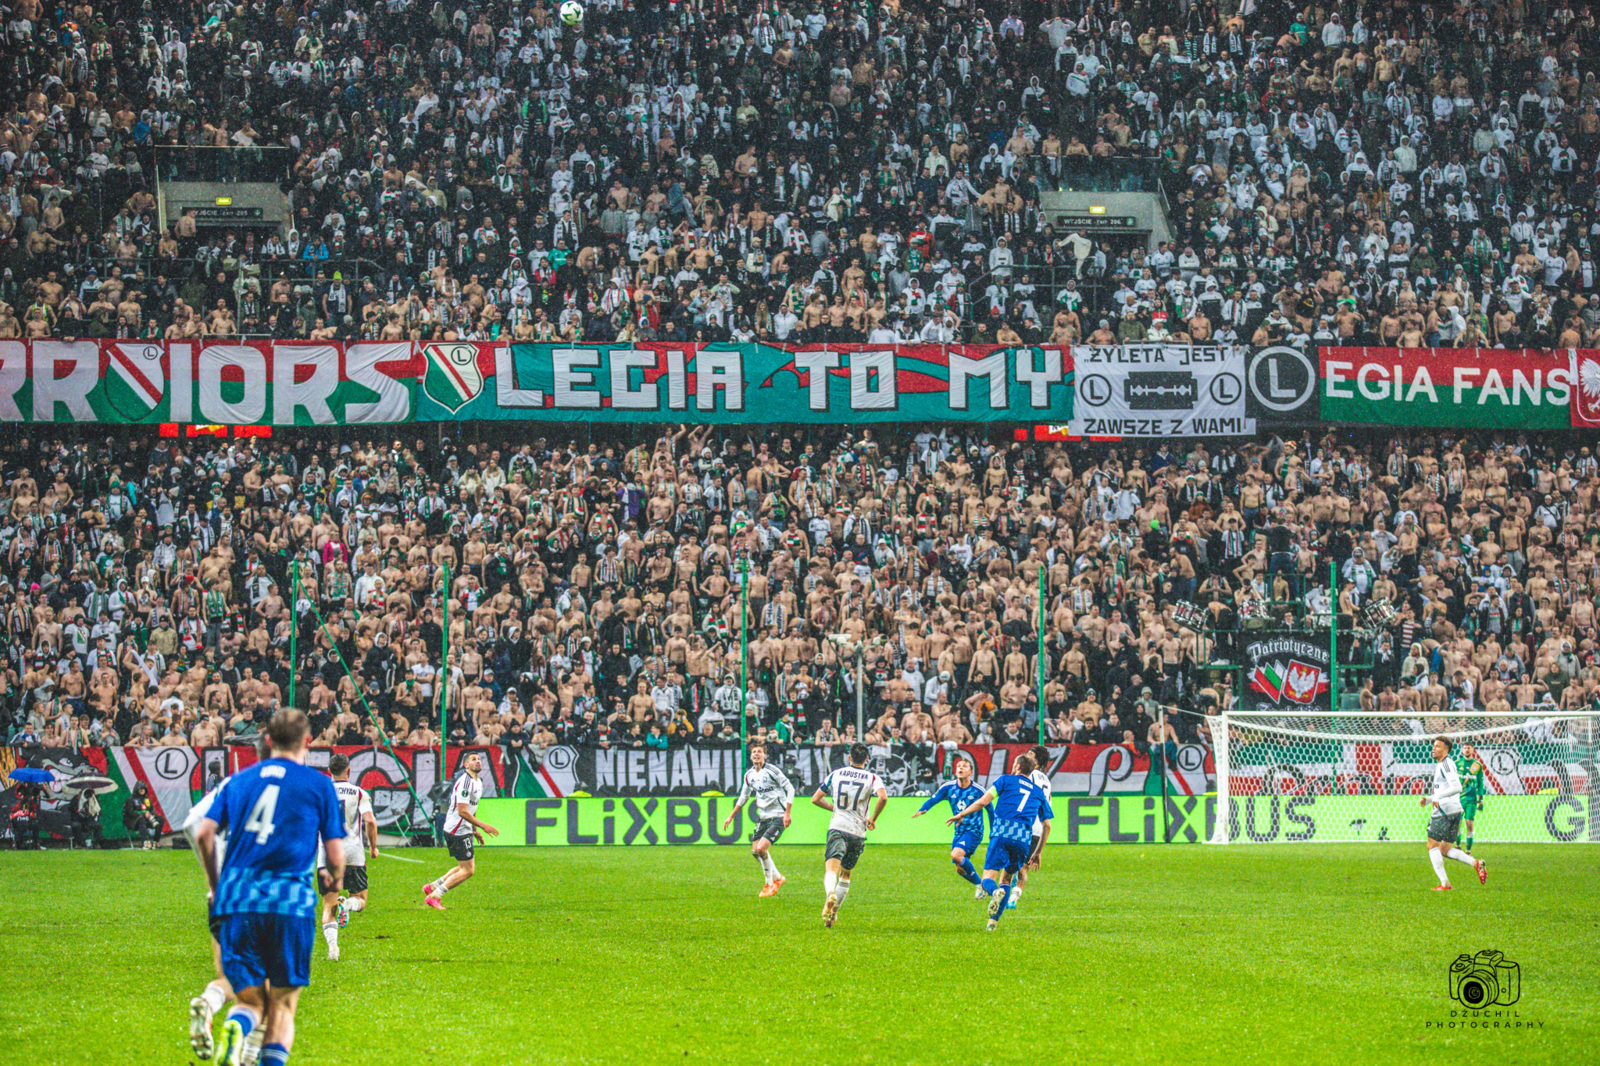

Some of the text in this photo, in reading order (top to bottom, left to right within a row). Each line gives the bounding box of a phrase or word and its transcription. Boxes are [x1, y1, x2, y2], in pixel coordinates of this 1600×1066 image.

[1179, 347, 1228, 365] JEST
[494, 347, 1064, 411] LEGIA TO MY
[1453, 367, 1571, 406] FANS
[1084, 417, 1241, 435] ZAWSZE Z WAMI
[1247, 636, 1329, 664] Patriotyczne
[839, 770, 868, 780] KAPUSTKA
[837, 780, 865, 811] 67
[1017, 787, 1031, 812] 7
[245, 784, 280, 845] 4
[463, 838, 471, 849] 13
